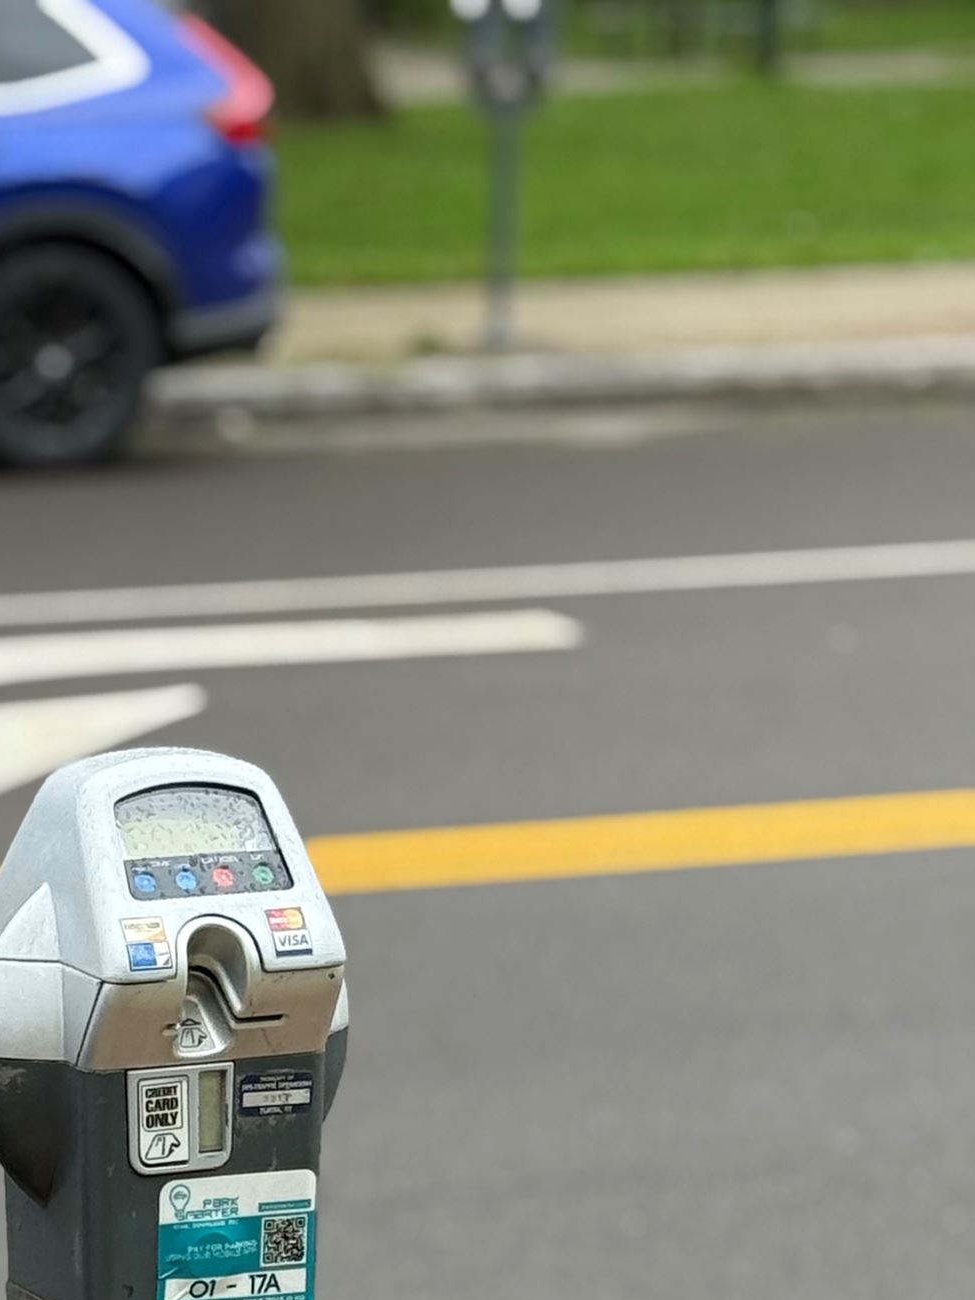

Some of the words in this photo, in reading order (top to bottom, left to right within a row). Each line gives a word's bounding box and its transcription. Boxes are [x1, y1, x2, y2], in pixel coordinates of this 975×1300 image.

[278, 933, 310, 947] VISA
[145, 1084, 179, 1098] CREDIT
[145, 1097, 179, 1113] CARD
[145, 1111, 179, 1129] ONLY
[203, 1196, 239, 1209] PARK
[174, 1206, 240, 1222] SMARTER
[248, 1272, 281, 1295] 17A
